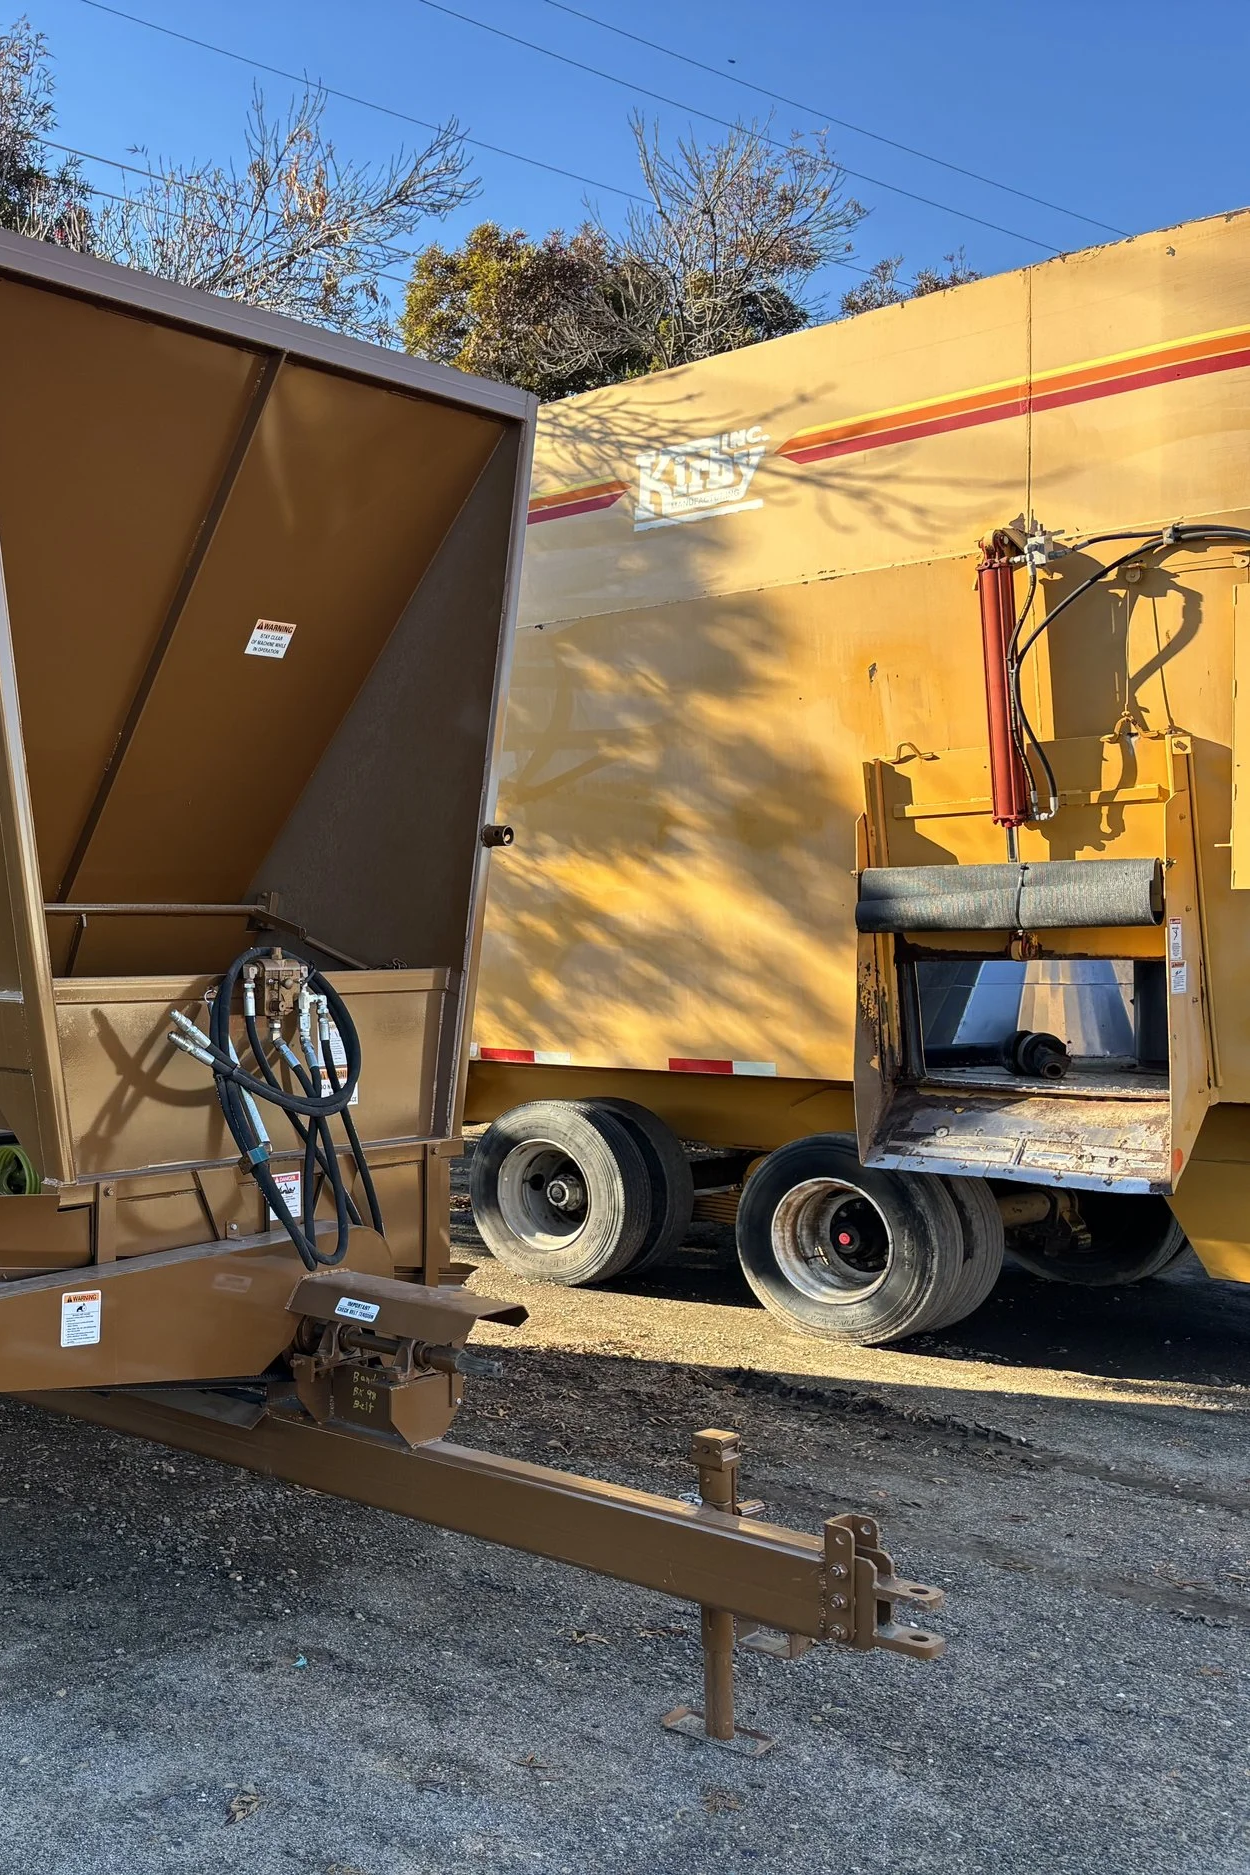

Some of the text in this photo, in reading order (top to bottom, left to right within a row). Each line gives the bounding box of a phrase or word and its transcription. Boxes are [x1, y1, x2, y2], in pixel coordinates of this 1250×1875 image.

[721, 426, 770, 450] INC.
[634, 440, 766, 520] Kirby
[263, 623, 294, 634] WARNING
[258, 647, 280, 655] OPERATION
[72, 1294, 97, 1303] WARNING
[347, 1301, 371, 1311] IMPORTANT
[358, 1311, 375, 1320] TENSION
[352, 1399, 375, 1414] Belt
